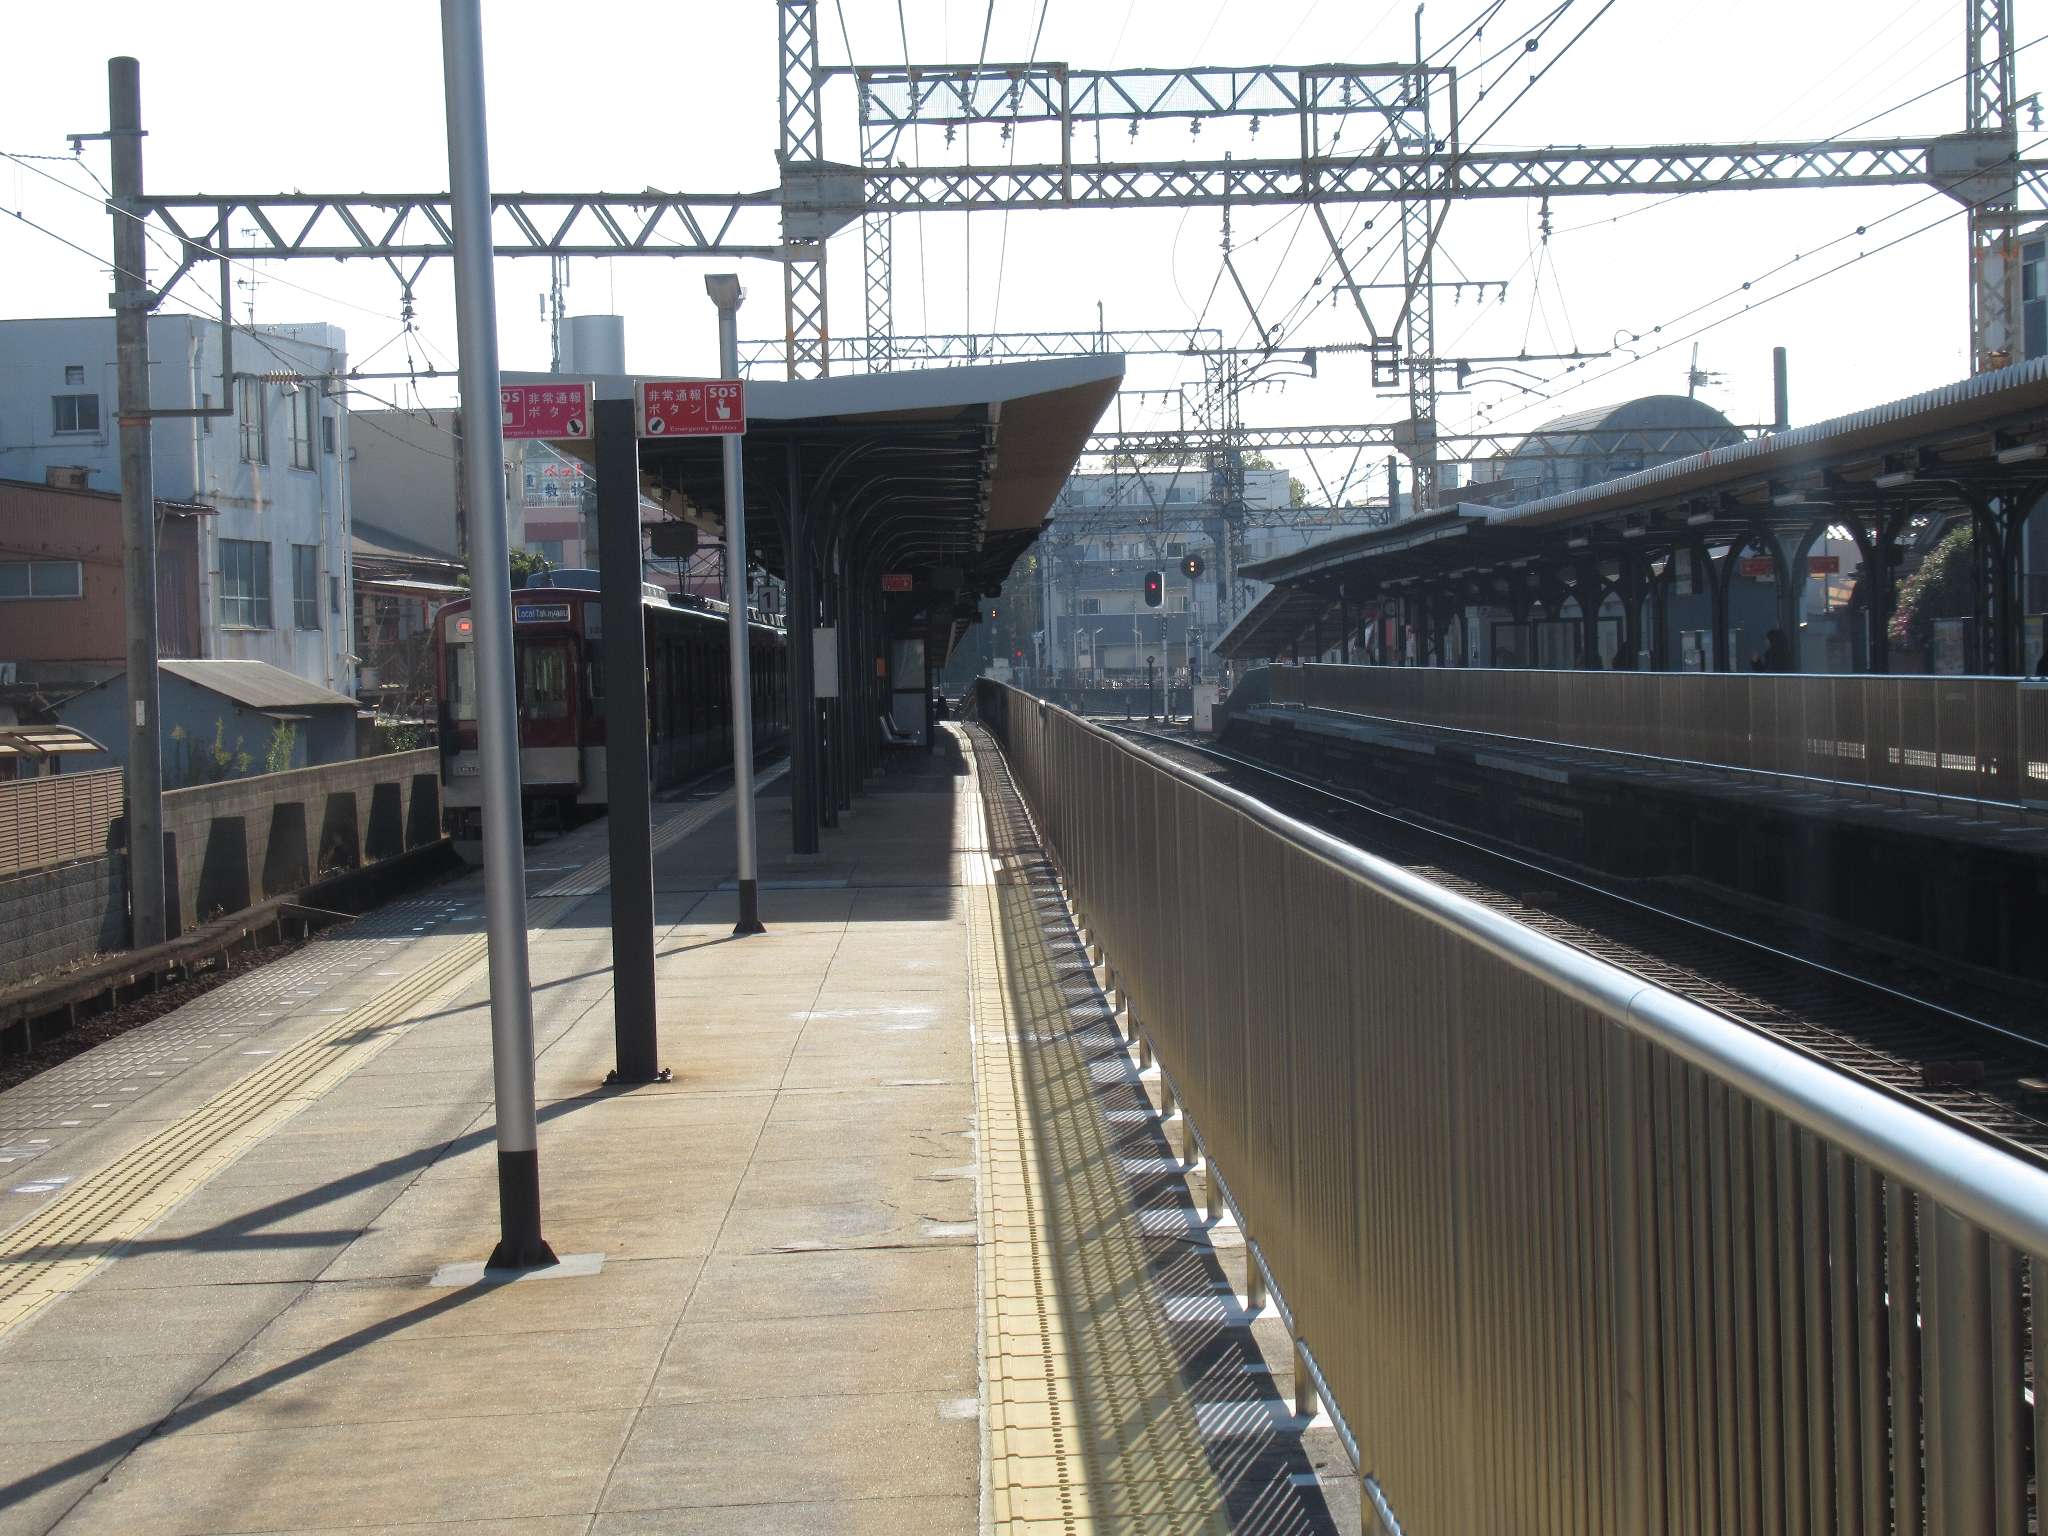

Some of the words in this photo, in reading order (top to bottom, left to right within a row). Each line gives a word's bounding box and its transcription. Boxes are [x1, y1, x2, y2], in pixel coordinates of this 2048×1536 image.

[528, 392, 582, 404] 非常通報
[649, 387, 702, 401] 非常通報
[709, 387, 737, 398] SOS
[528, 406, 582, 418] ボタン
[649, 403, 702, 415] ボタン
[670, 425, 709, 433] Emergency
[762, 591, 771, 609] 1
[518, 608, 535, 618] Local
